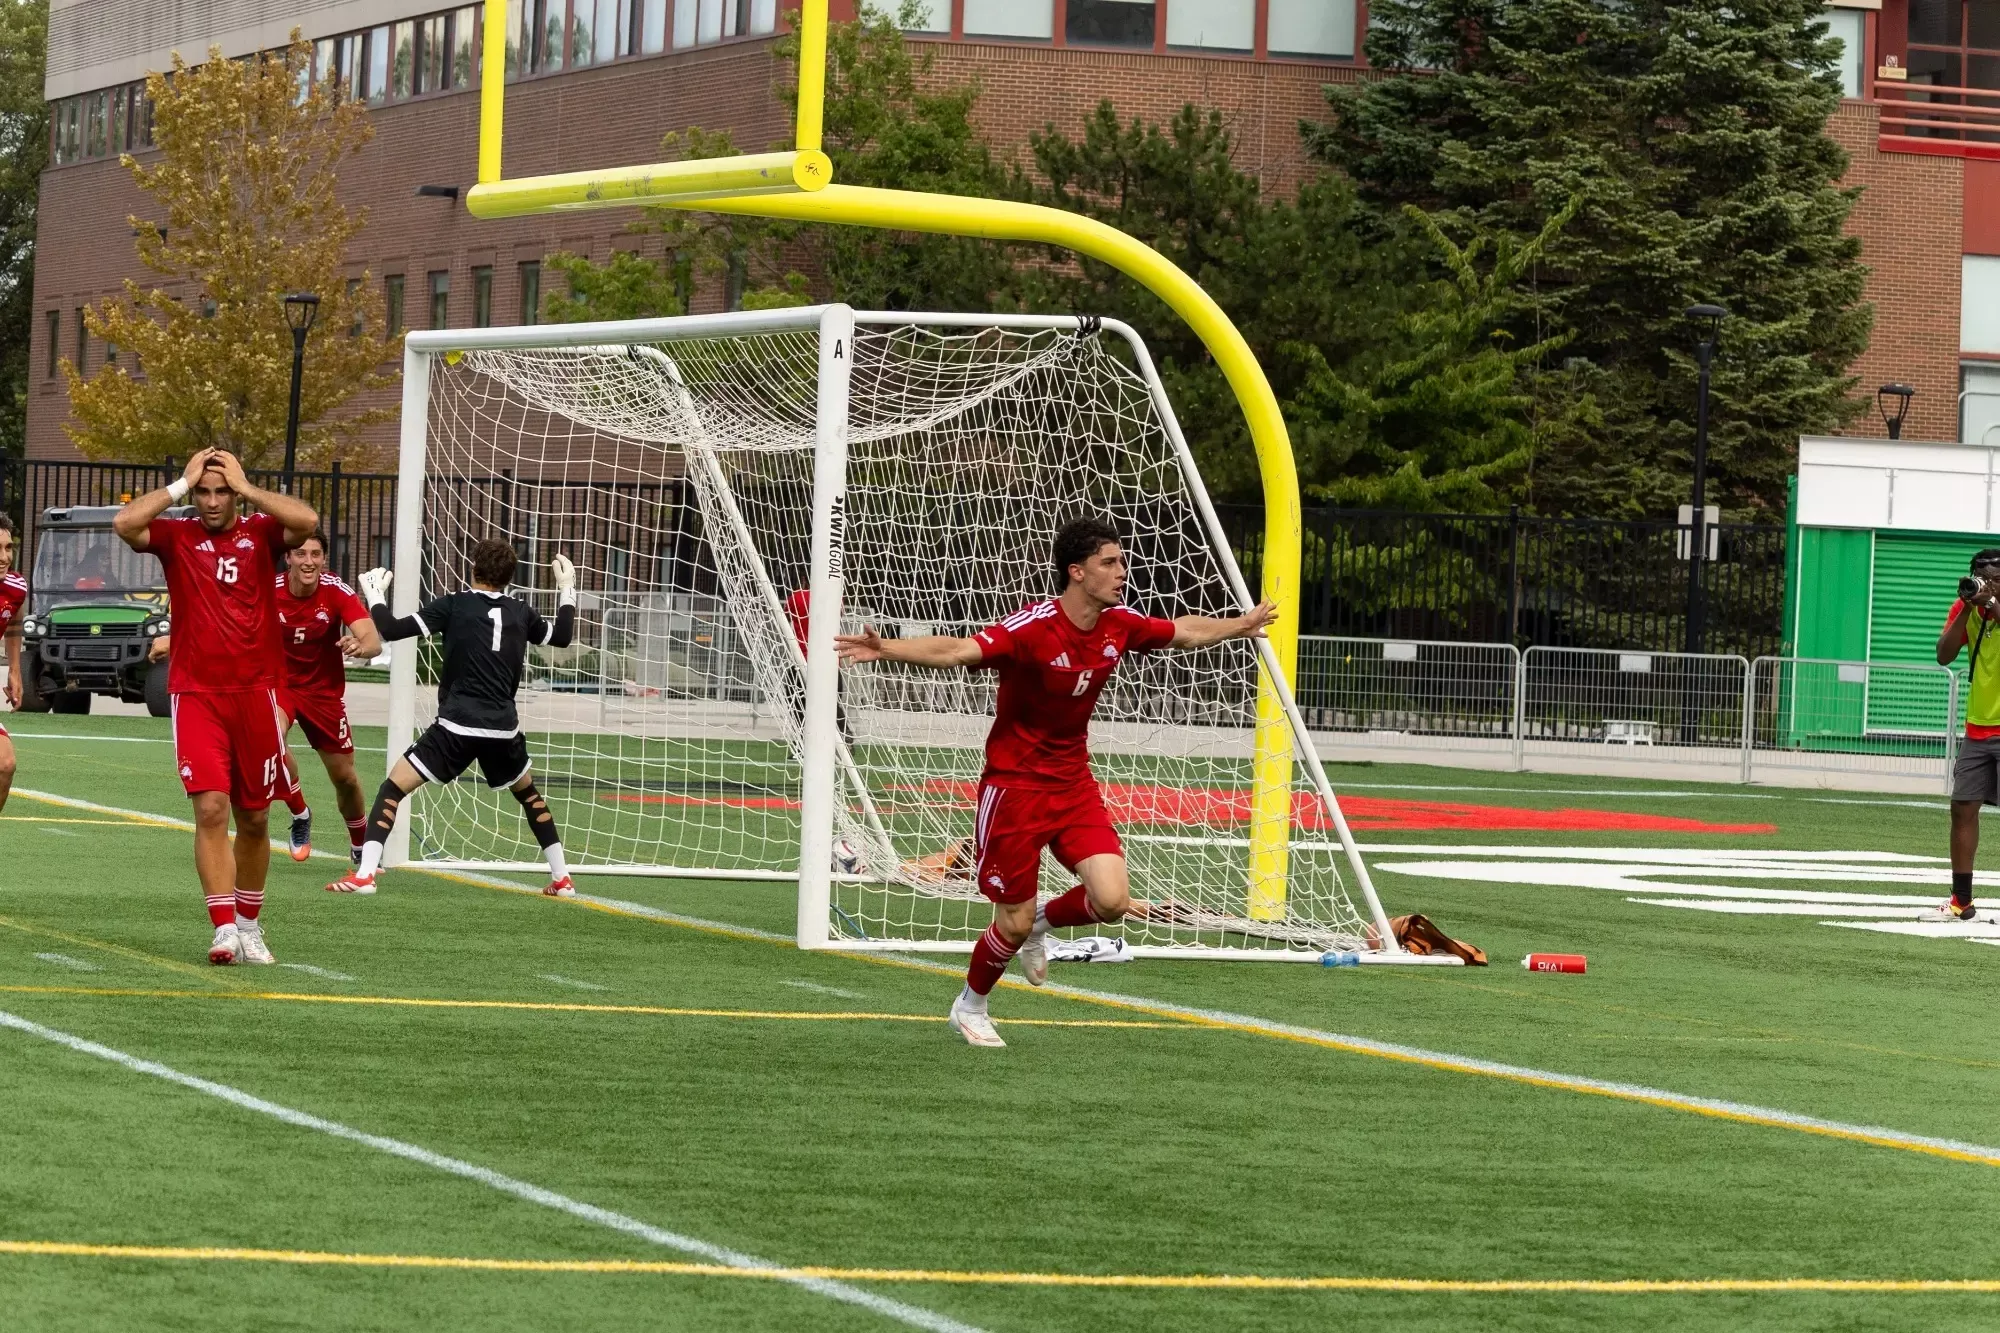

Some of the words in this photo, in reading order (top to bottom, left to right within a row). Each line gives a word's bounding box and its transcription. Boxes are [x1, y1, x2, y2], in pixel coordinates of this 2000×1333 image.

[834, 339, 844, 359] A
[216, 556, 239, 584] 15
[293, 627, 306, 645] 5
[487, 607, 503, 652] 1
[1072, 670, 1093, 696] 6
[338, 717, 348, 740] 5
[263, 753, 278, 787] 15
